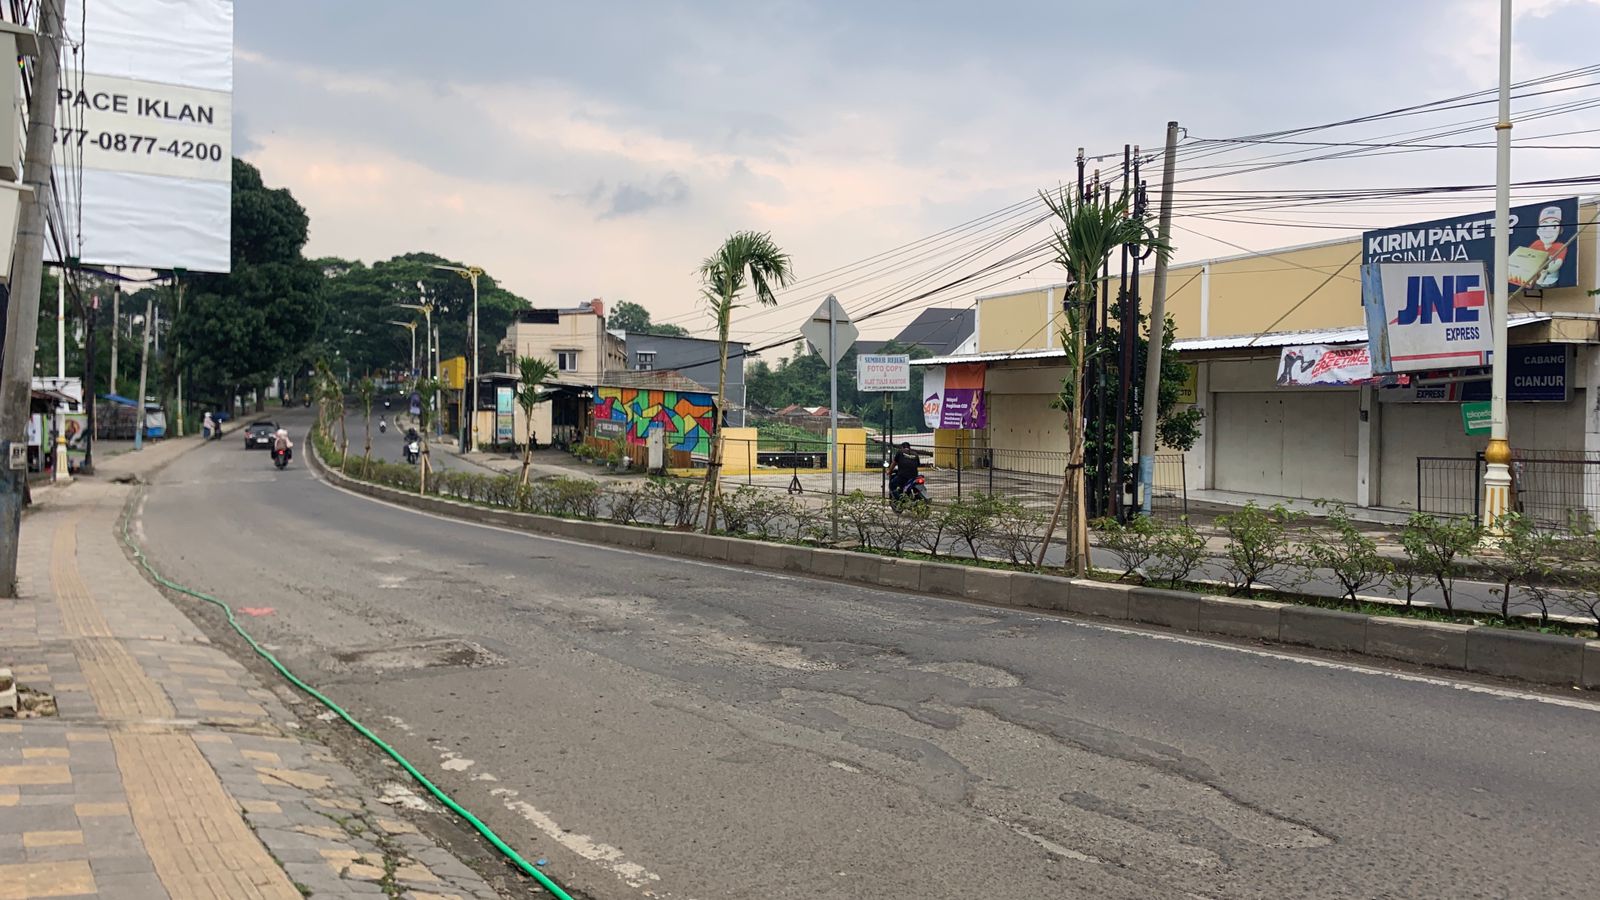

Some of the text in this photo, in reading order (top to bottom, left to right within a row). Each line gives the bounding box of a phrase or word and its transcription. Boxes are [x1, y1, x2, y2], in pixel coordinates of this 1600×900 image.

[137, 97, 214, 124] IKLAN
[1368, 229, 1426, 254] KIRIM
[1430, 244, 1470, 262] AJA
[1397, 274, 1484, 326] JNE
[1446, 327, 1480, 341] EXPRESS
[1524, 355, 1565, 365] CABANG
[1514, 375, 1564, 387] CIANJUR
[1416, 389, 1446, 399] EXPRESS
